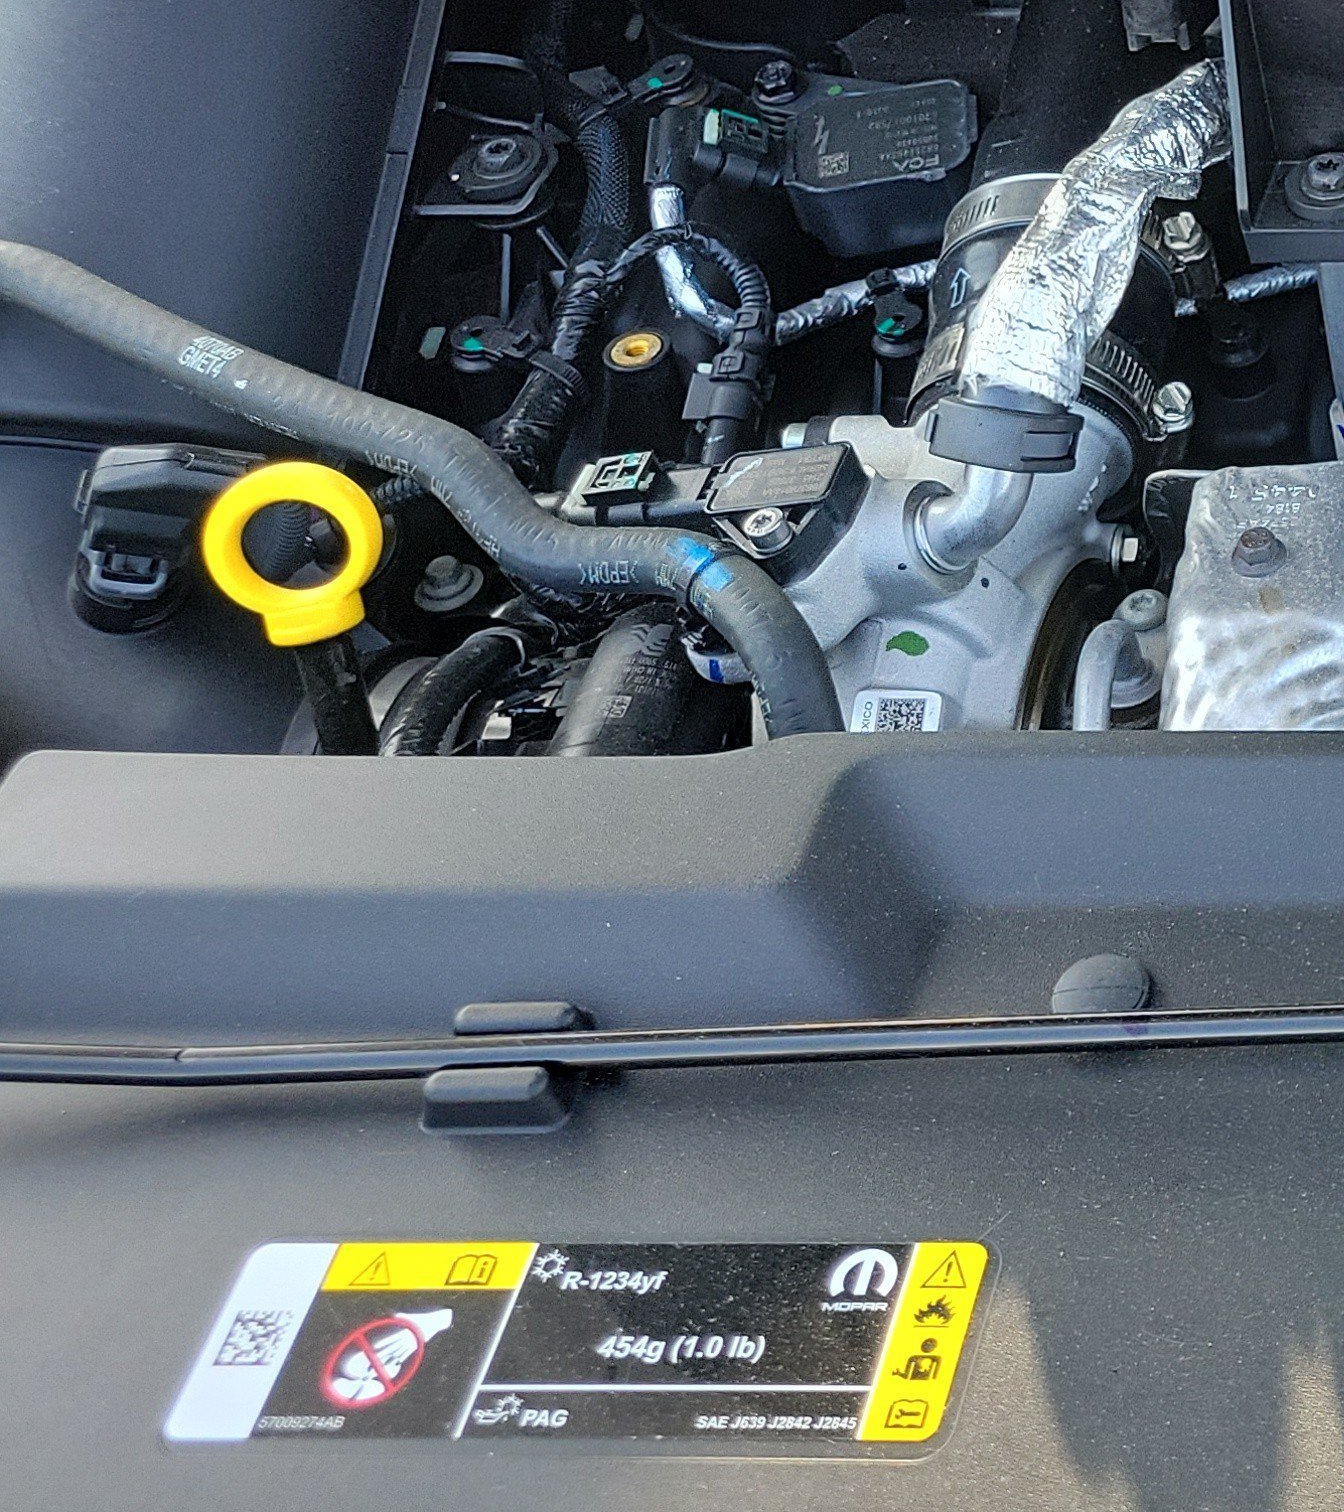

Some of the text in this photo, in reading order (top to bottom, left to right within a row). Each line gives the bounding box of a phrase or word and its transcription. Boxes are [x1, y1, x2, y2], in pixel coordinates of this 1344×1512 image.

[861, 701, 873, 732] XICO
[560, 1271, 669, 1295] R-1234yf
[820, 1301, 889, 1312] MOPAR
[597, 1335, 767, 1365] 454g (1.0 lb)
[518, 1408, 570, 1428] PAG
[695, 1415, 859, 1431] SAE J639 J2842 J2845
